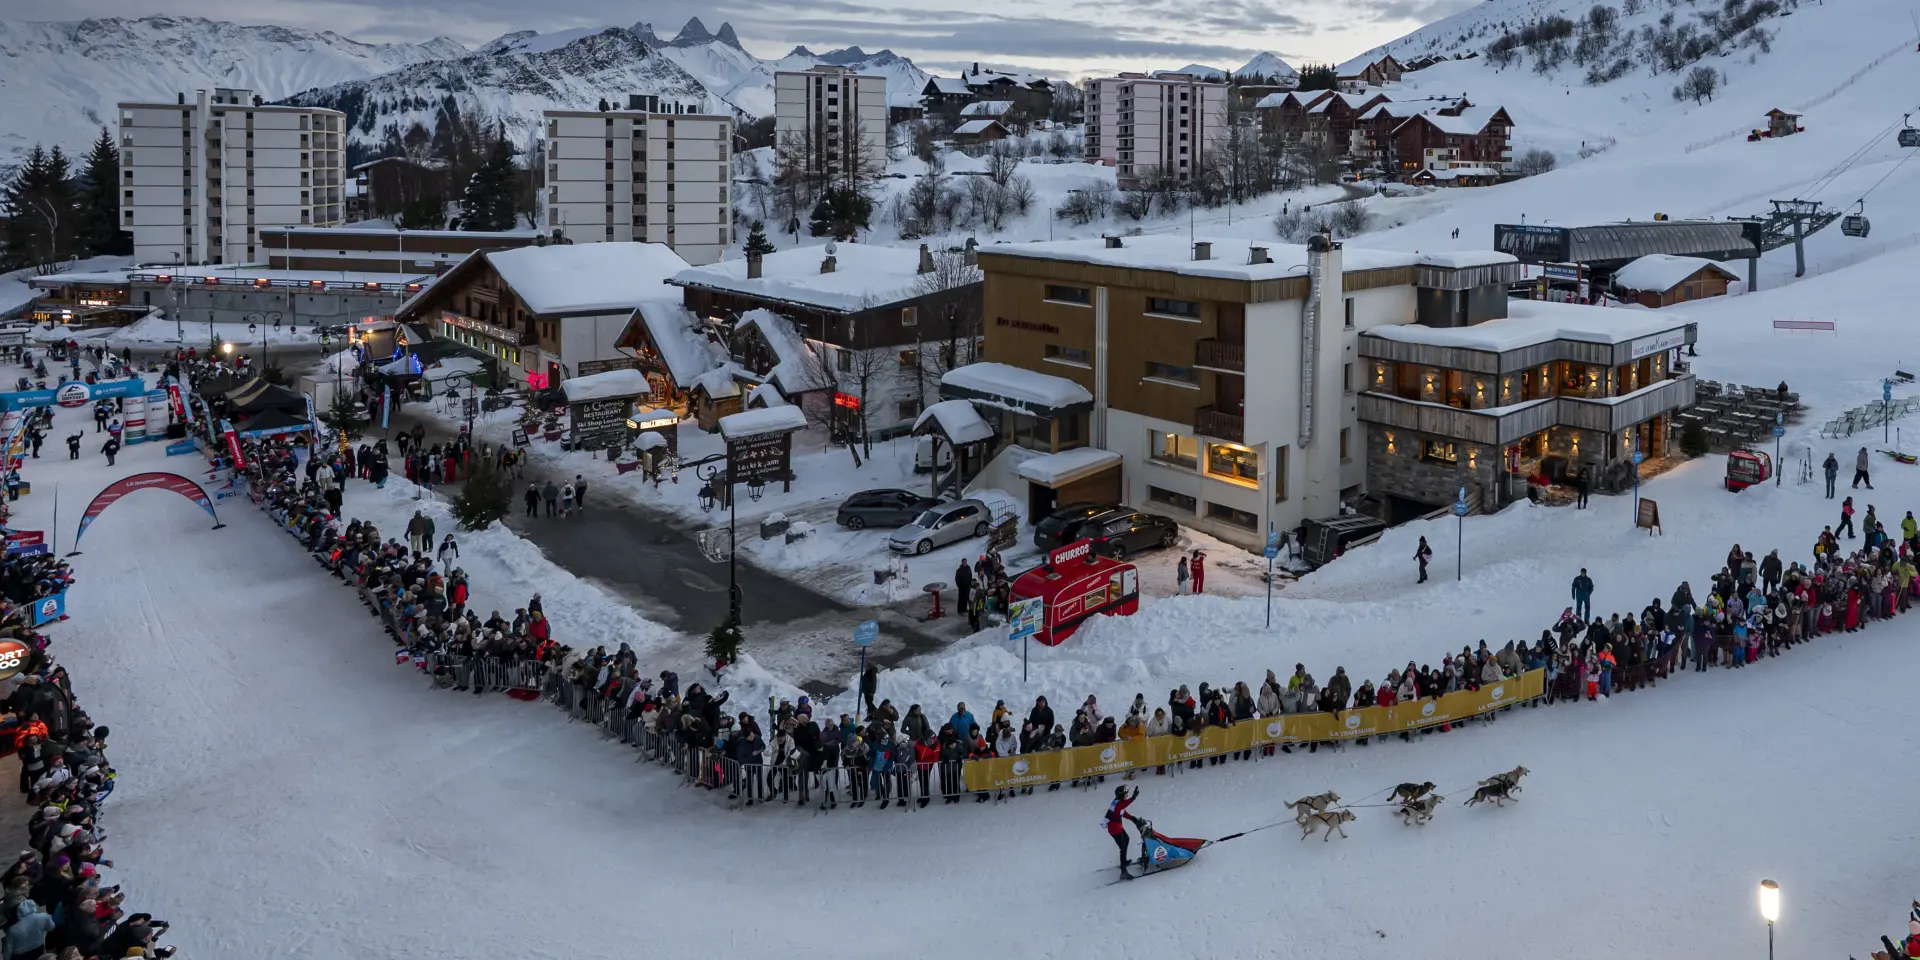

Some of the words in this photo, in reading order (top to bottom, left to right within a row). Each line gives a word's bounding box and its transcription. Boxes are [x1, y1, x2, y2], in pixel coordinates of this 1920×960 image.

[592, 400, 625, 411] Chamois
[583, 408, 622, 419] RESTAURANT
[587, 420, 603, 428] Shop
[750, 440, 782, 448] RESTAURANT
[225, 490, 237, 498] ici
[1055, 543, 1090, 565] CHURROS
[1094, 760, 1134, 772] TOUSSUIRE
[1007, 774, 1047, 785] TOUSSUIRE
